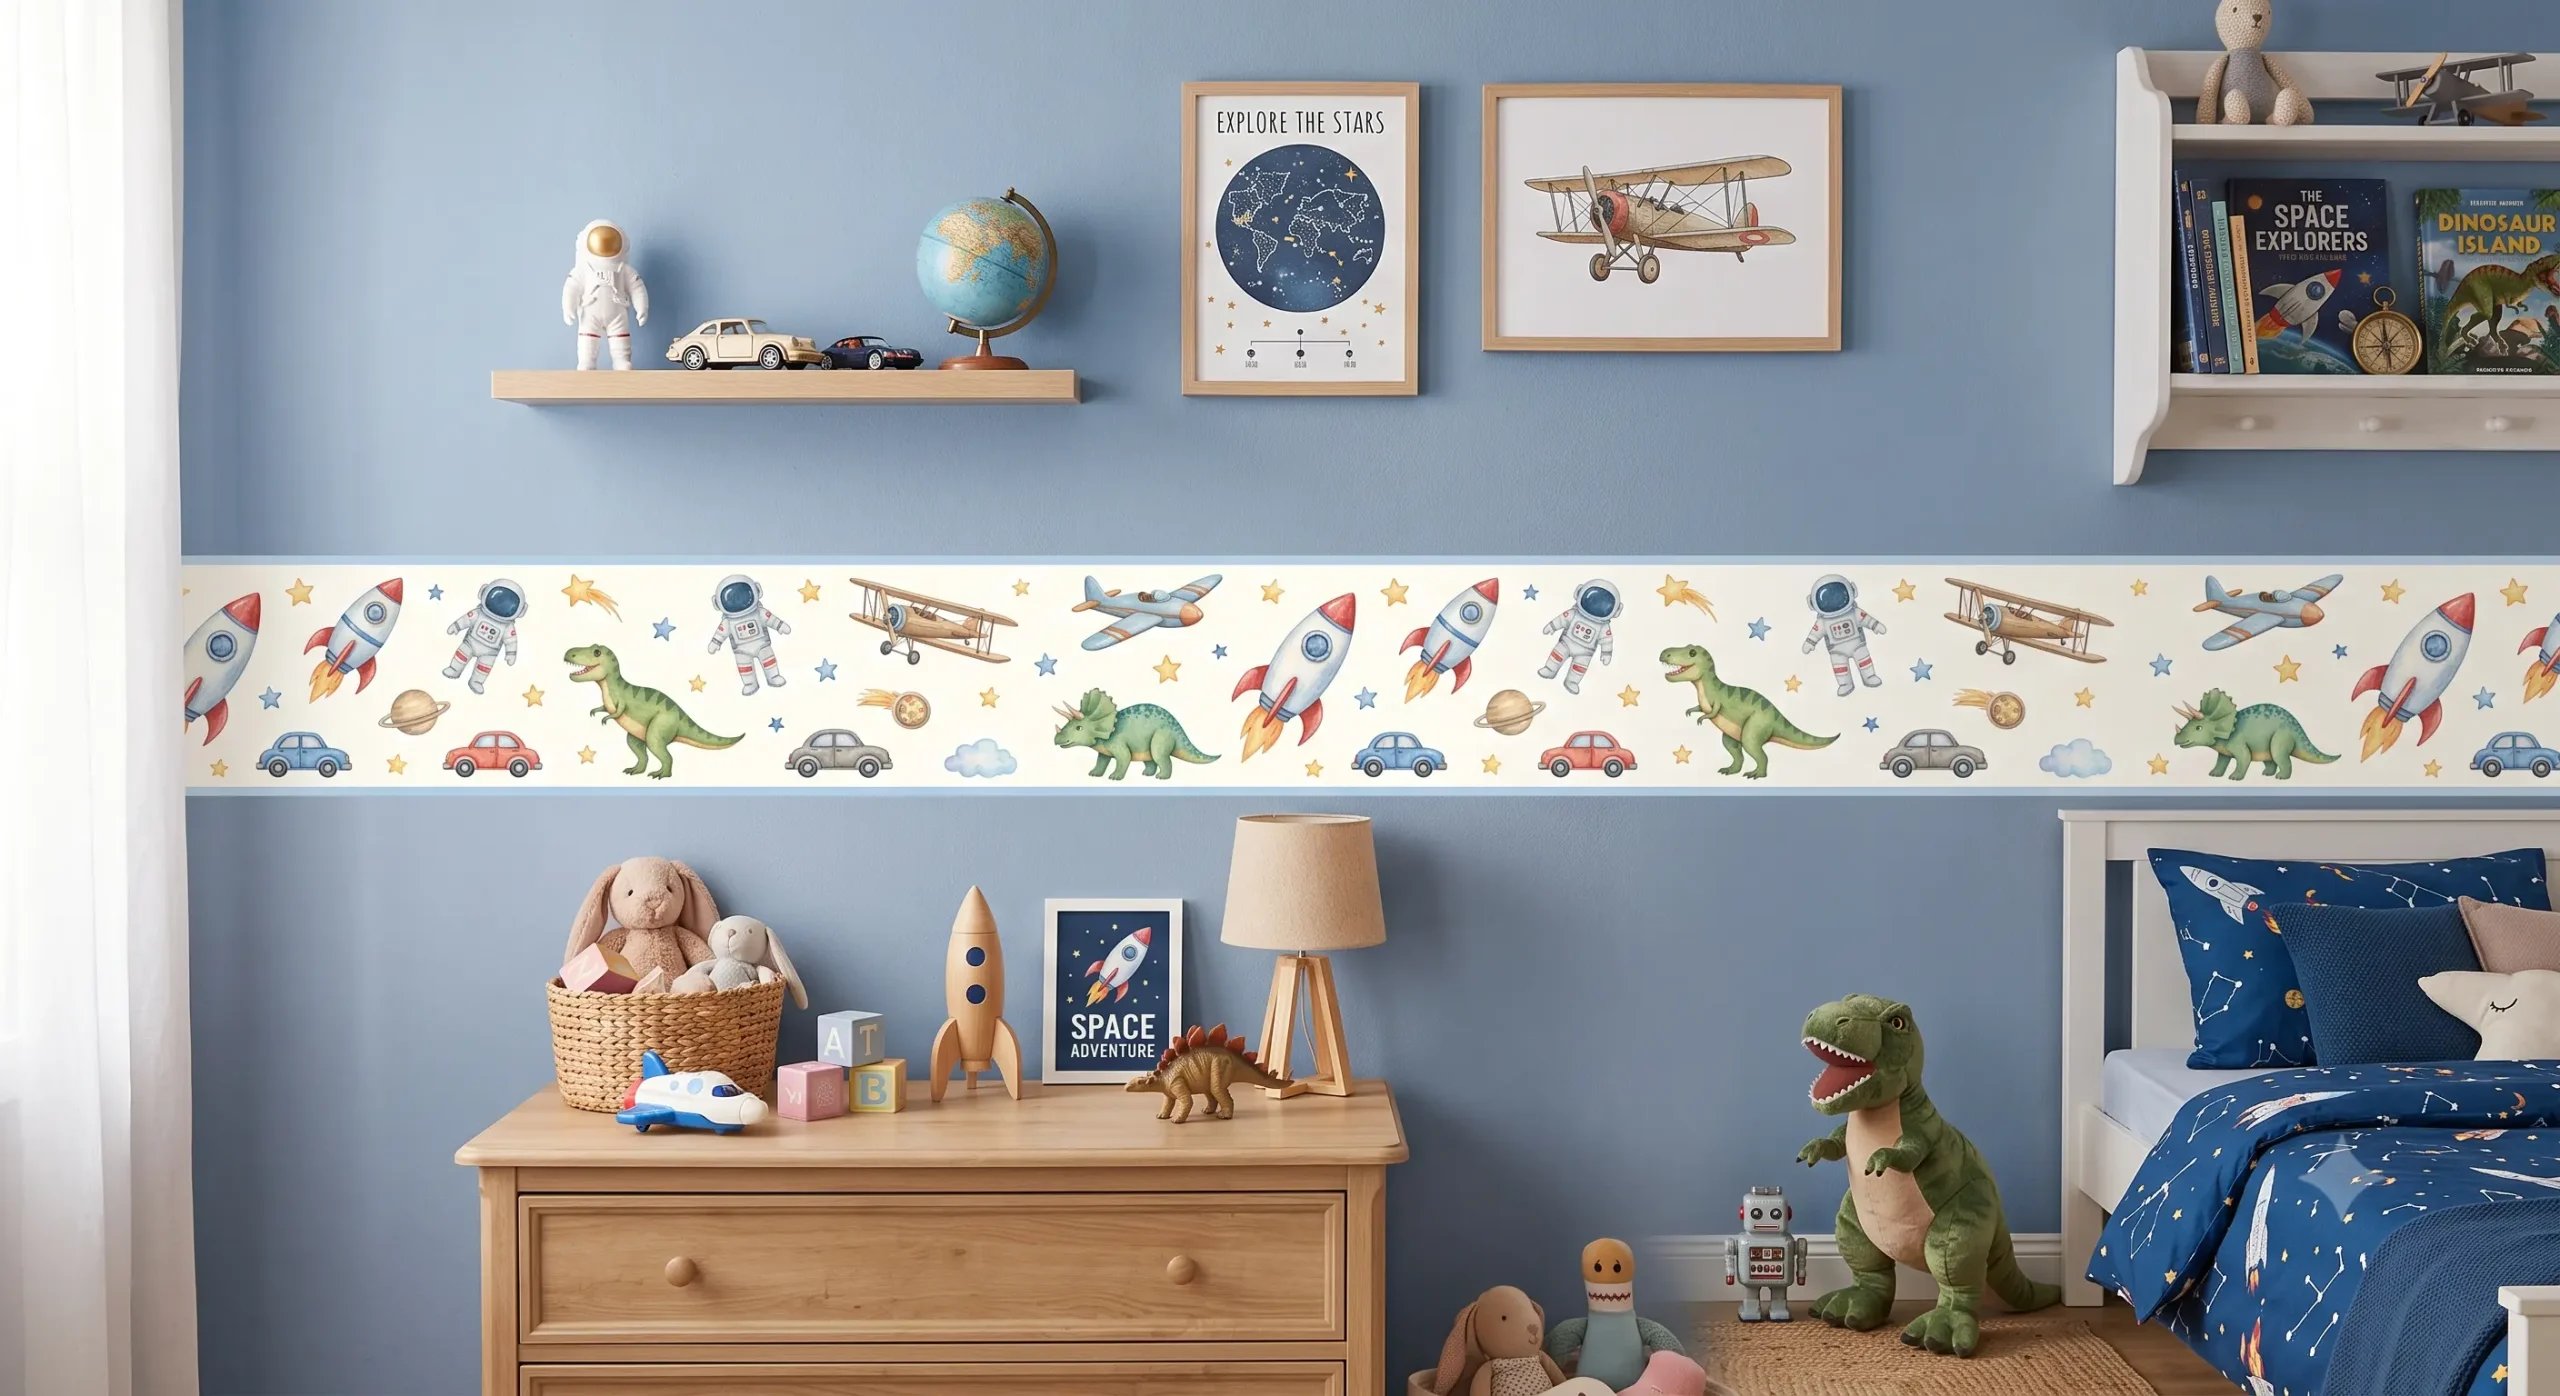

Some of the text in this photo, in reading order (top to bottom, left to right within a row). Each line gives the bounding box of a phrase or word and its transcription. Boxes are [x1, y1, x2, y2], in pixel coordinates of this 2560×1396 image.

[1217, 111, 1385, 134] EXPLORE THE STARS
[2300, 190, 2323, 202] THE
[2274, 204, 2350, 228] SPACE
[2438, 213, 2556, 233] DINOSAUR
[2255, 231, 2368, 251] EXPLORERS
[2458, 235, 2541, 254] ISLAND
[1071, 1013, 1155, 1040] SPACE
[823, 1026, 845, 1059] A
[859, 1023, 878, 1056] T
[1070, 1043, 1155, 1058] ADVENTURE
[860, 1073, 887, 1105] B
